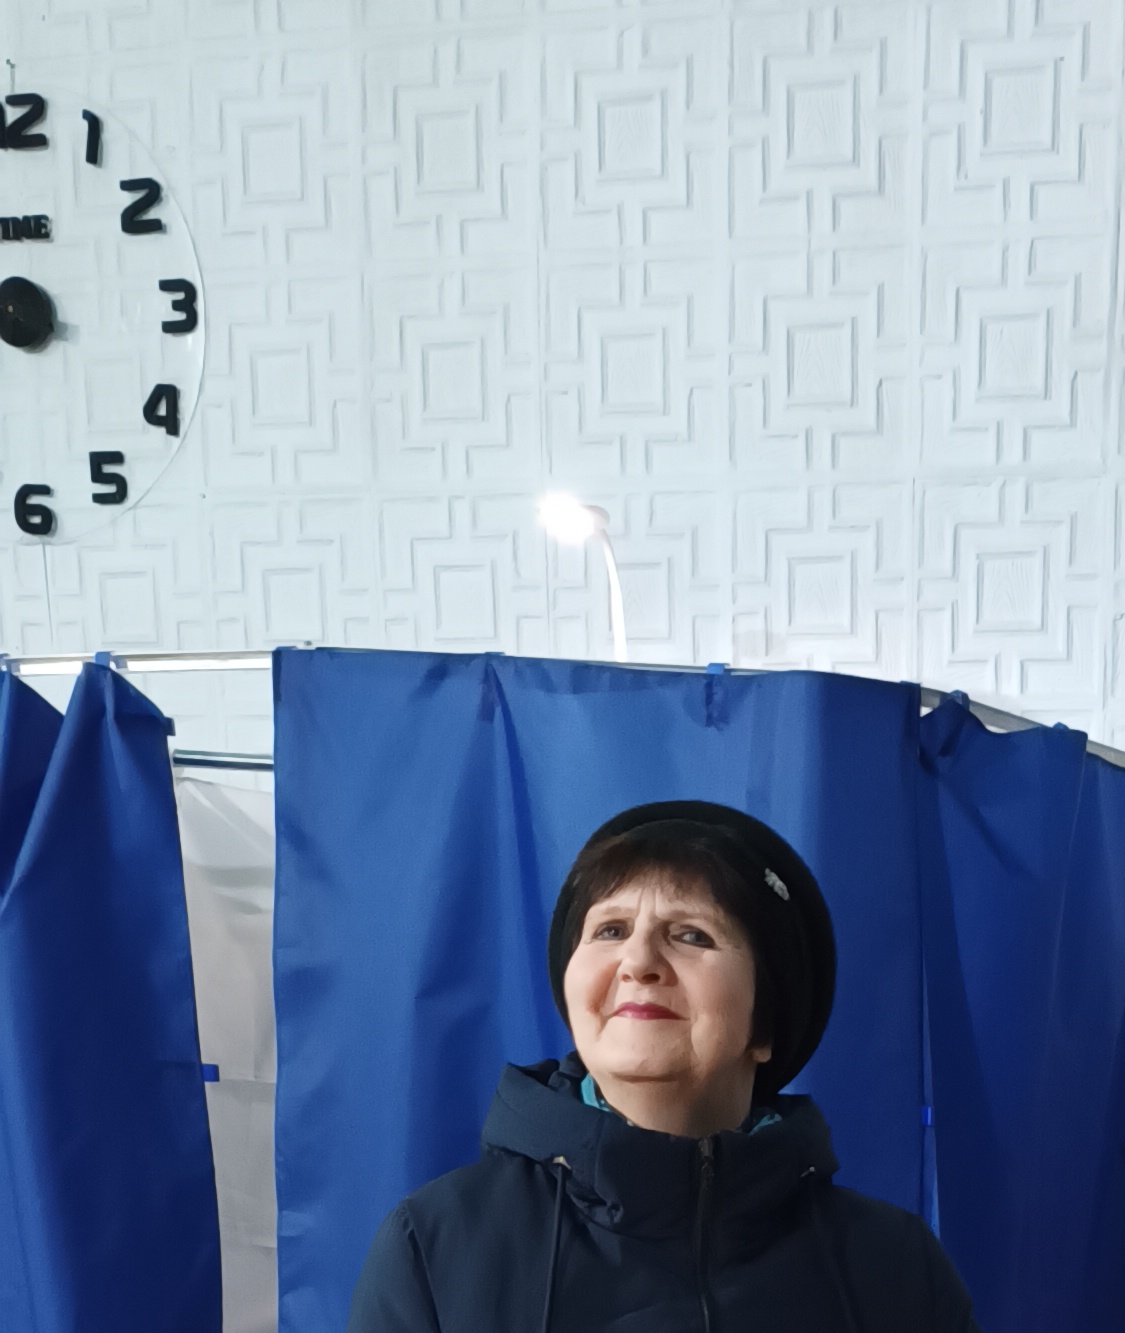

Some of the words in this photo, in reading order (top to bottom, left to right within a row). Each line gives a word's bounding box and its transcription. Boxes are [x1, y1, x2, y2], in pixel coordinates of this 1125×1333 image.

[82, 109, 100, 165] 1
[120, 178, 163, 234] 2
[158, 278, 198, 334] 3
[143, 384, 180, 436] 4
[89, 451, 127, 504] 5
[14, 484, 54, 535] 6
